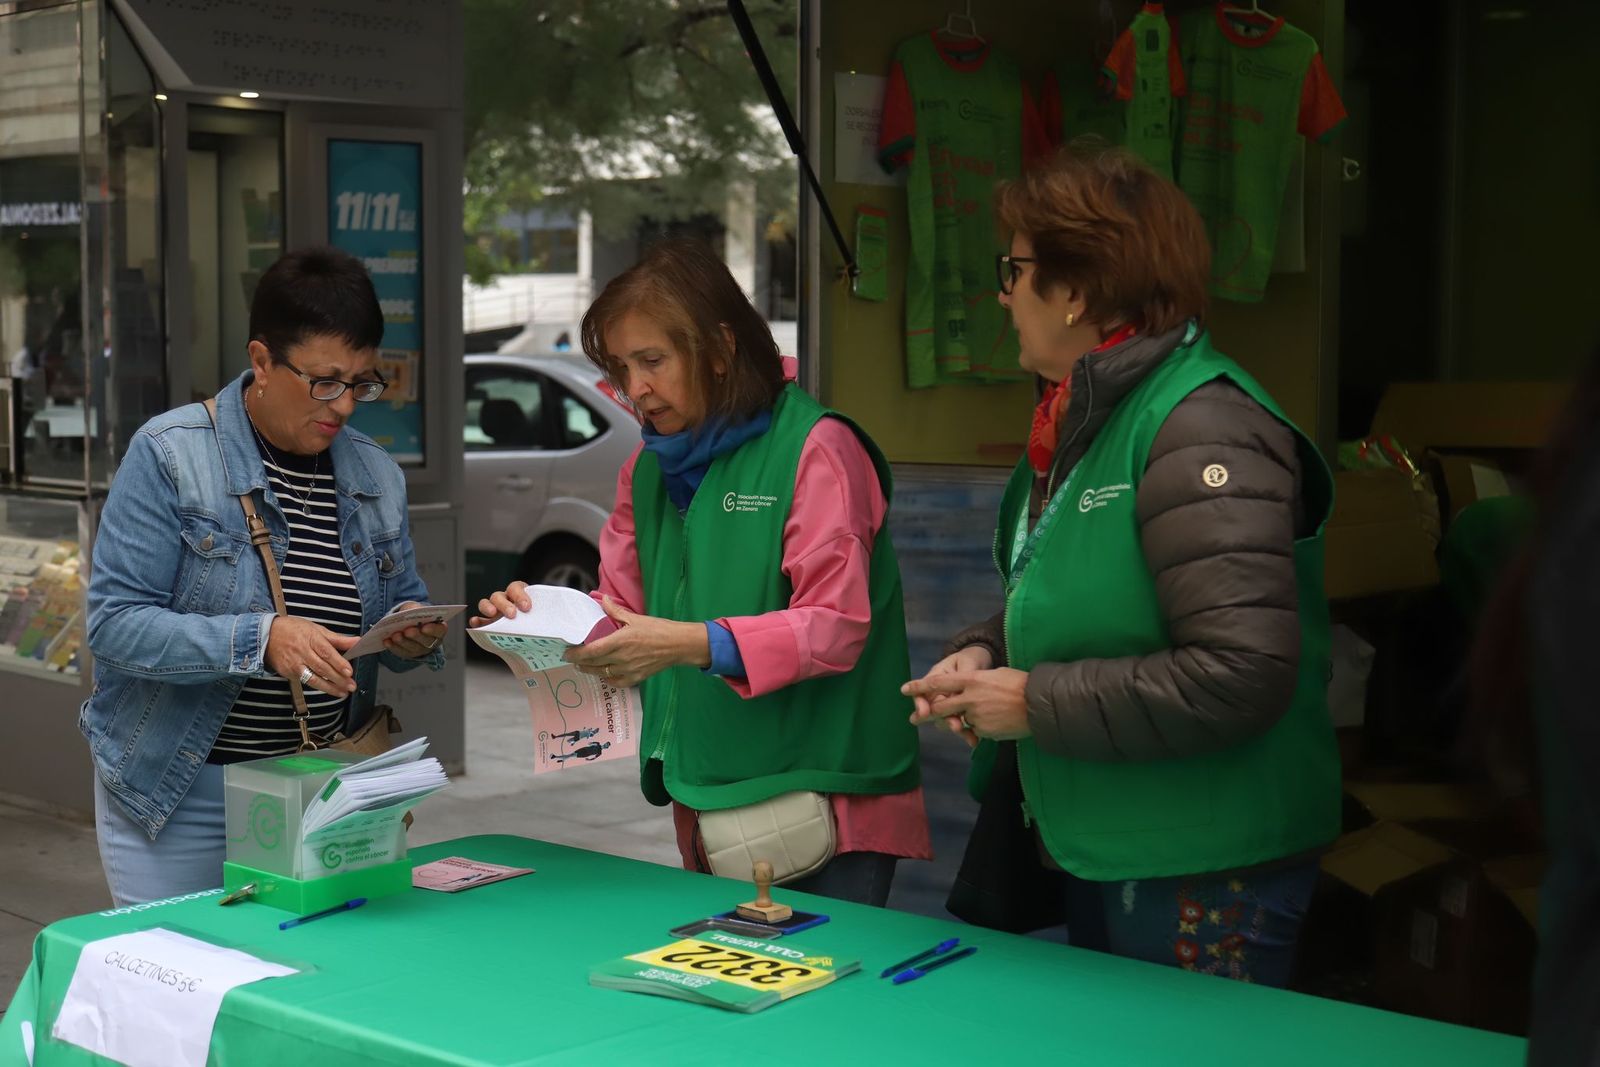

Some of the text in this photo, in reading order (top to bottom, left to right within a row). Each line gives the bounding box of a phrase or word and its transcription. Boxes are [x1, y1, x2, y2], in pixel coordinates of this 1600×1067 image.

[336, 191, 400, 231] 11/11
[603, 691, 611, 700] el
[605, 702, 613, 733] cáncer
[99, 888, 225, 917] asociación
[711, 934, 804, 958] CAJA RURAL
[104, 951, 203, 993] CALCETINES 5€
[661, 945, 812, 985] 3322
